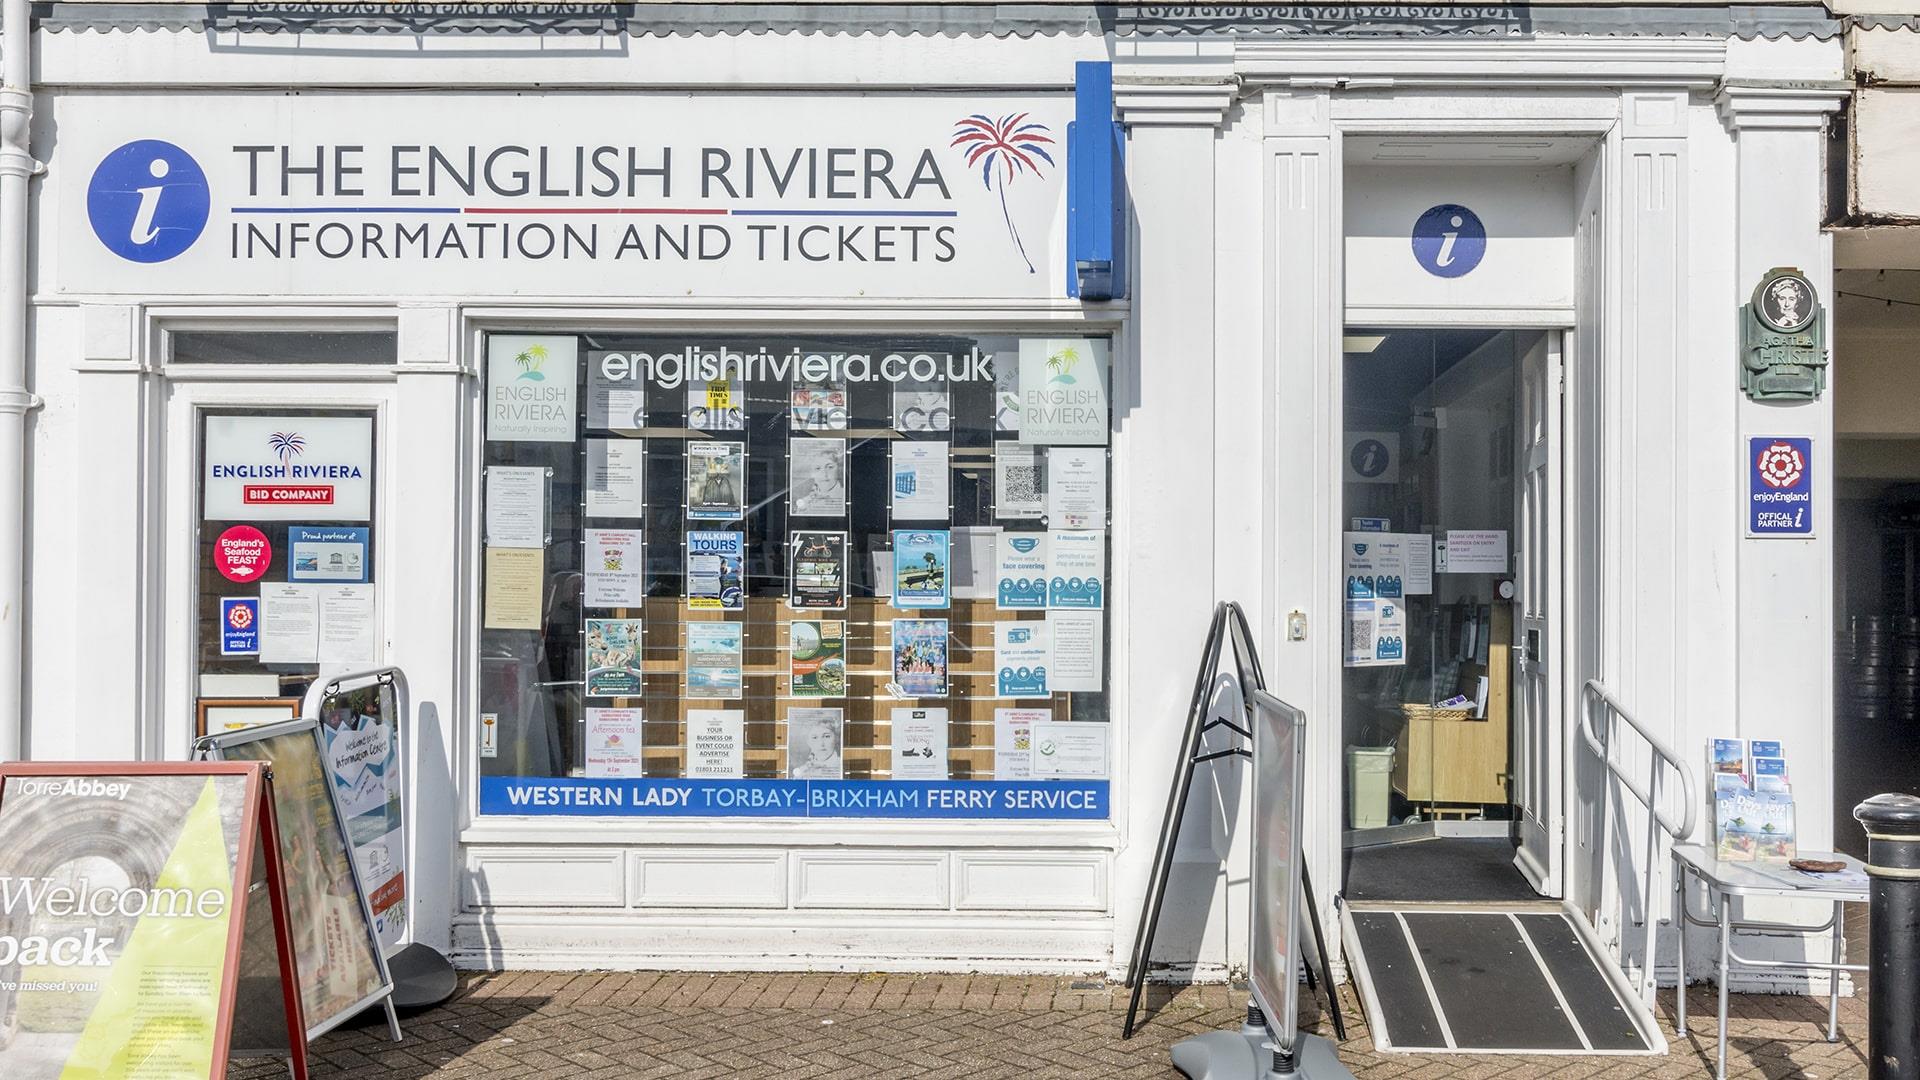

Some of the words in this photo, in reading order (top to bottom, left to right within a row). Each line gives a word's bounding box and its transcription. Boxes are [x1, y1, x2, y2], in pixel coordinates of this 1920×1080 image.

[232, 145, 364, 198] THE
[392, 146, 672, 198] ENGLISH
[702, 146, 952, 199] RIVIERA
[232, 222, 597, 260] INFORMATION
[614, 223, 732, 261] AND
[747, 224, 956, 263] TICKETS
[1763, 336, 1814, 346] AGATHA
[1743, 345, 1829, 371] CHRISTIE
[602, 346, 994, 389] englishriviera.co.uk
[495, 386, 568, 402] ENGLISH
[1027, 389, 1099, 405] ENGLISH
[495, 404, 568, 421] RIVIERA
[1027, 407, 1100, 424] RIVIERA
[495, 423, 531, 436] Naturally
[533, 424, 568, 437] Inspiring
[1027, 428, 1064, 438] Naturally
[1065, 428, 1100, 438] Inspiring
[213, 465, 286, 478] ENGLISH
[292, 466, 362, 479] RIVIERA
[249, 489, 270, 501] BID
[271, 489, 329, 502] COMPANY
[1753, 491, 1809, 503] enjoyEngland
[1757, 520, 1793, 528] PARTNER
[302, 531, 322, 540] Proud
[322, 532, 348, 542] partner
[221, 538, 265, 549] England's
[693, 540, 737, 550] TOURS
[224, 547, 261, 556] Seafood
[227, 556, 258, 564] FEAST
[506, 786, 623, 805] WESTERN
[632, 787, 693, 807] LADY
[702, 788, 919, 808] TORBAY-BRIXHAM
[927, 789, 998, 809] FERRY
[1004, 789, 1098, 809] SERVICE
[0, 876, 225, 918] Welcome
[20, 980, 65, 992] missed
[69, 981, 98, 996] you!
